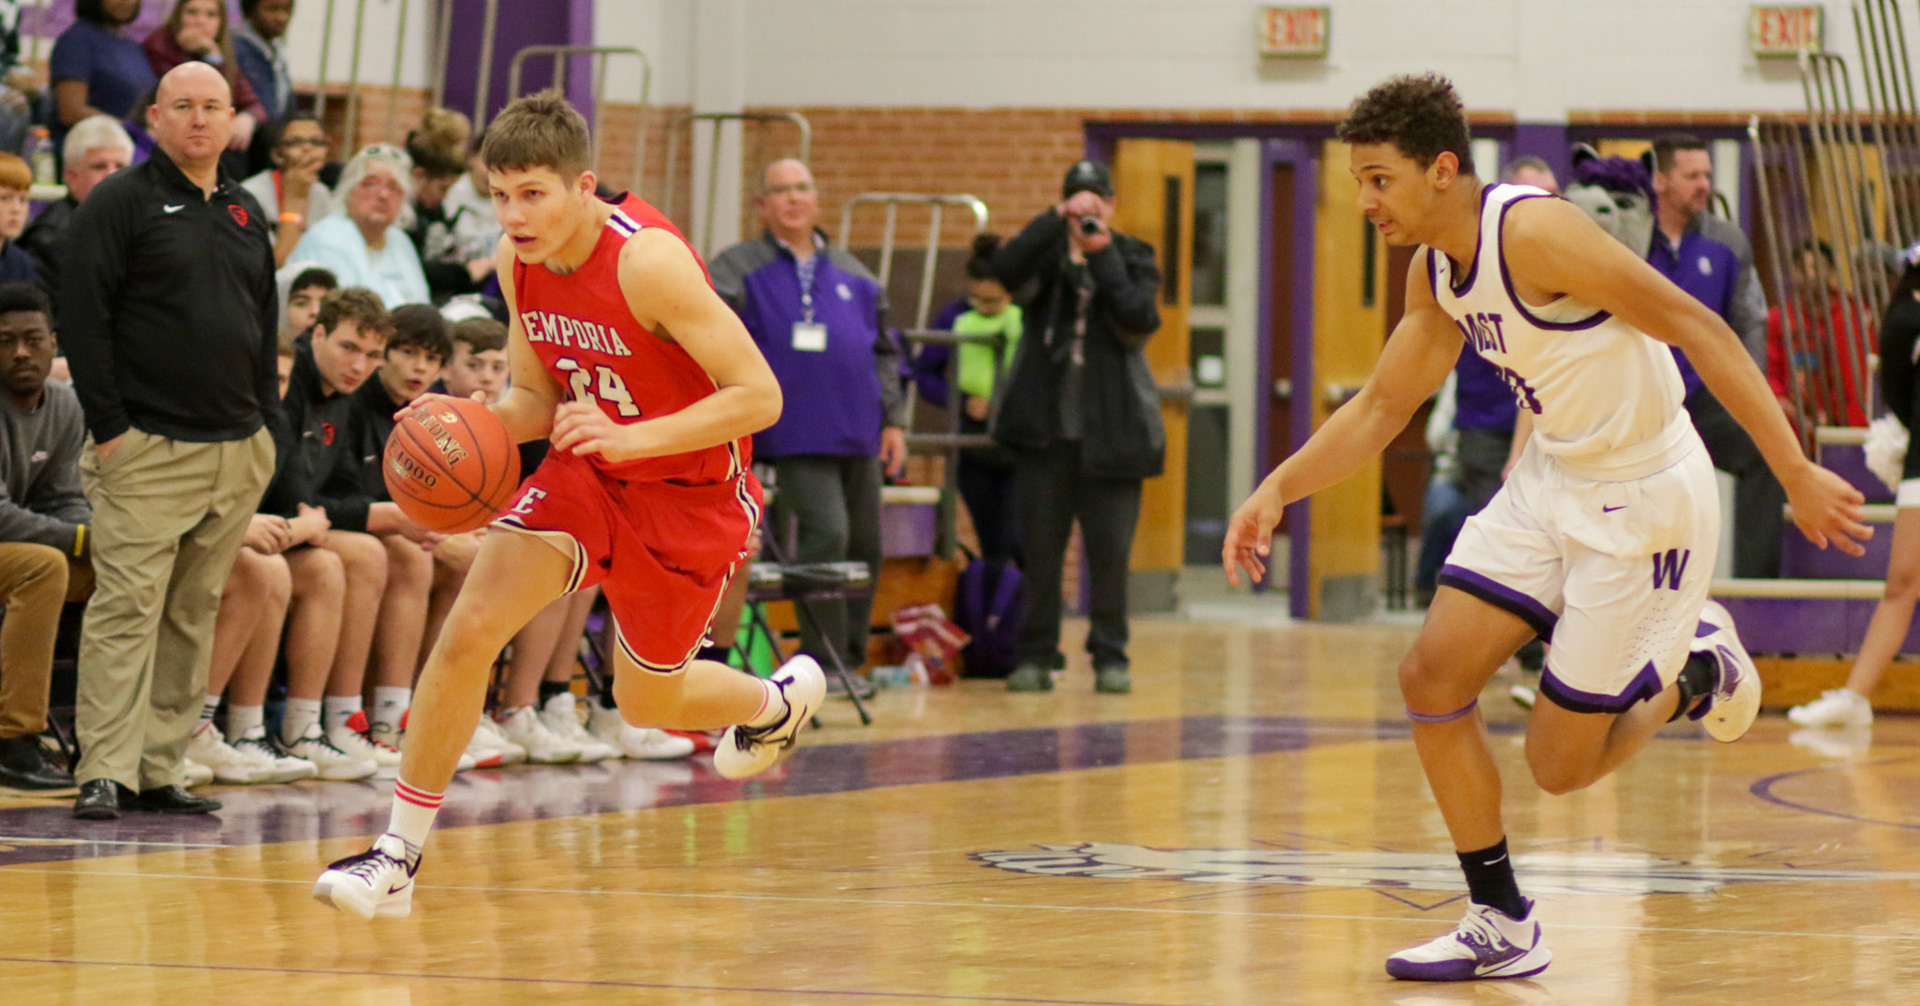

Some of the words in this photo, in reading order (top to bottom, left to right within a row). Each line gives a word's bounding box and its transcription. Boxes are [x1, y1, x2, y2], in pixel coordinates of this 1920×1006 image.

[1266, 9, 1321, 48] EXIT
[1759, 8, 1813, 46] EXIT
[521, 310, 633, 356] EMPORIA
[555, 357, 642, 417] 24
[396, 450, 438, 488] 1000
[511, 487, 548, 514] E
[1652, 548, 1691, 590] W
